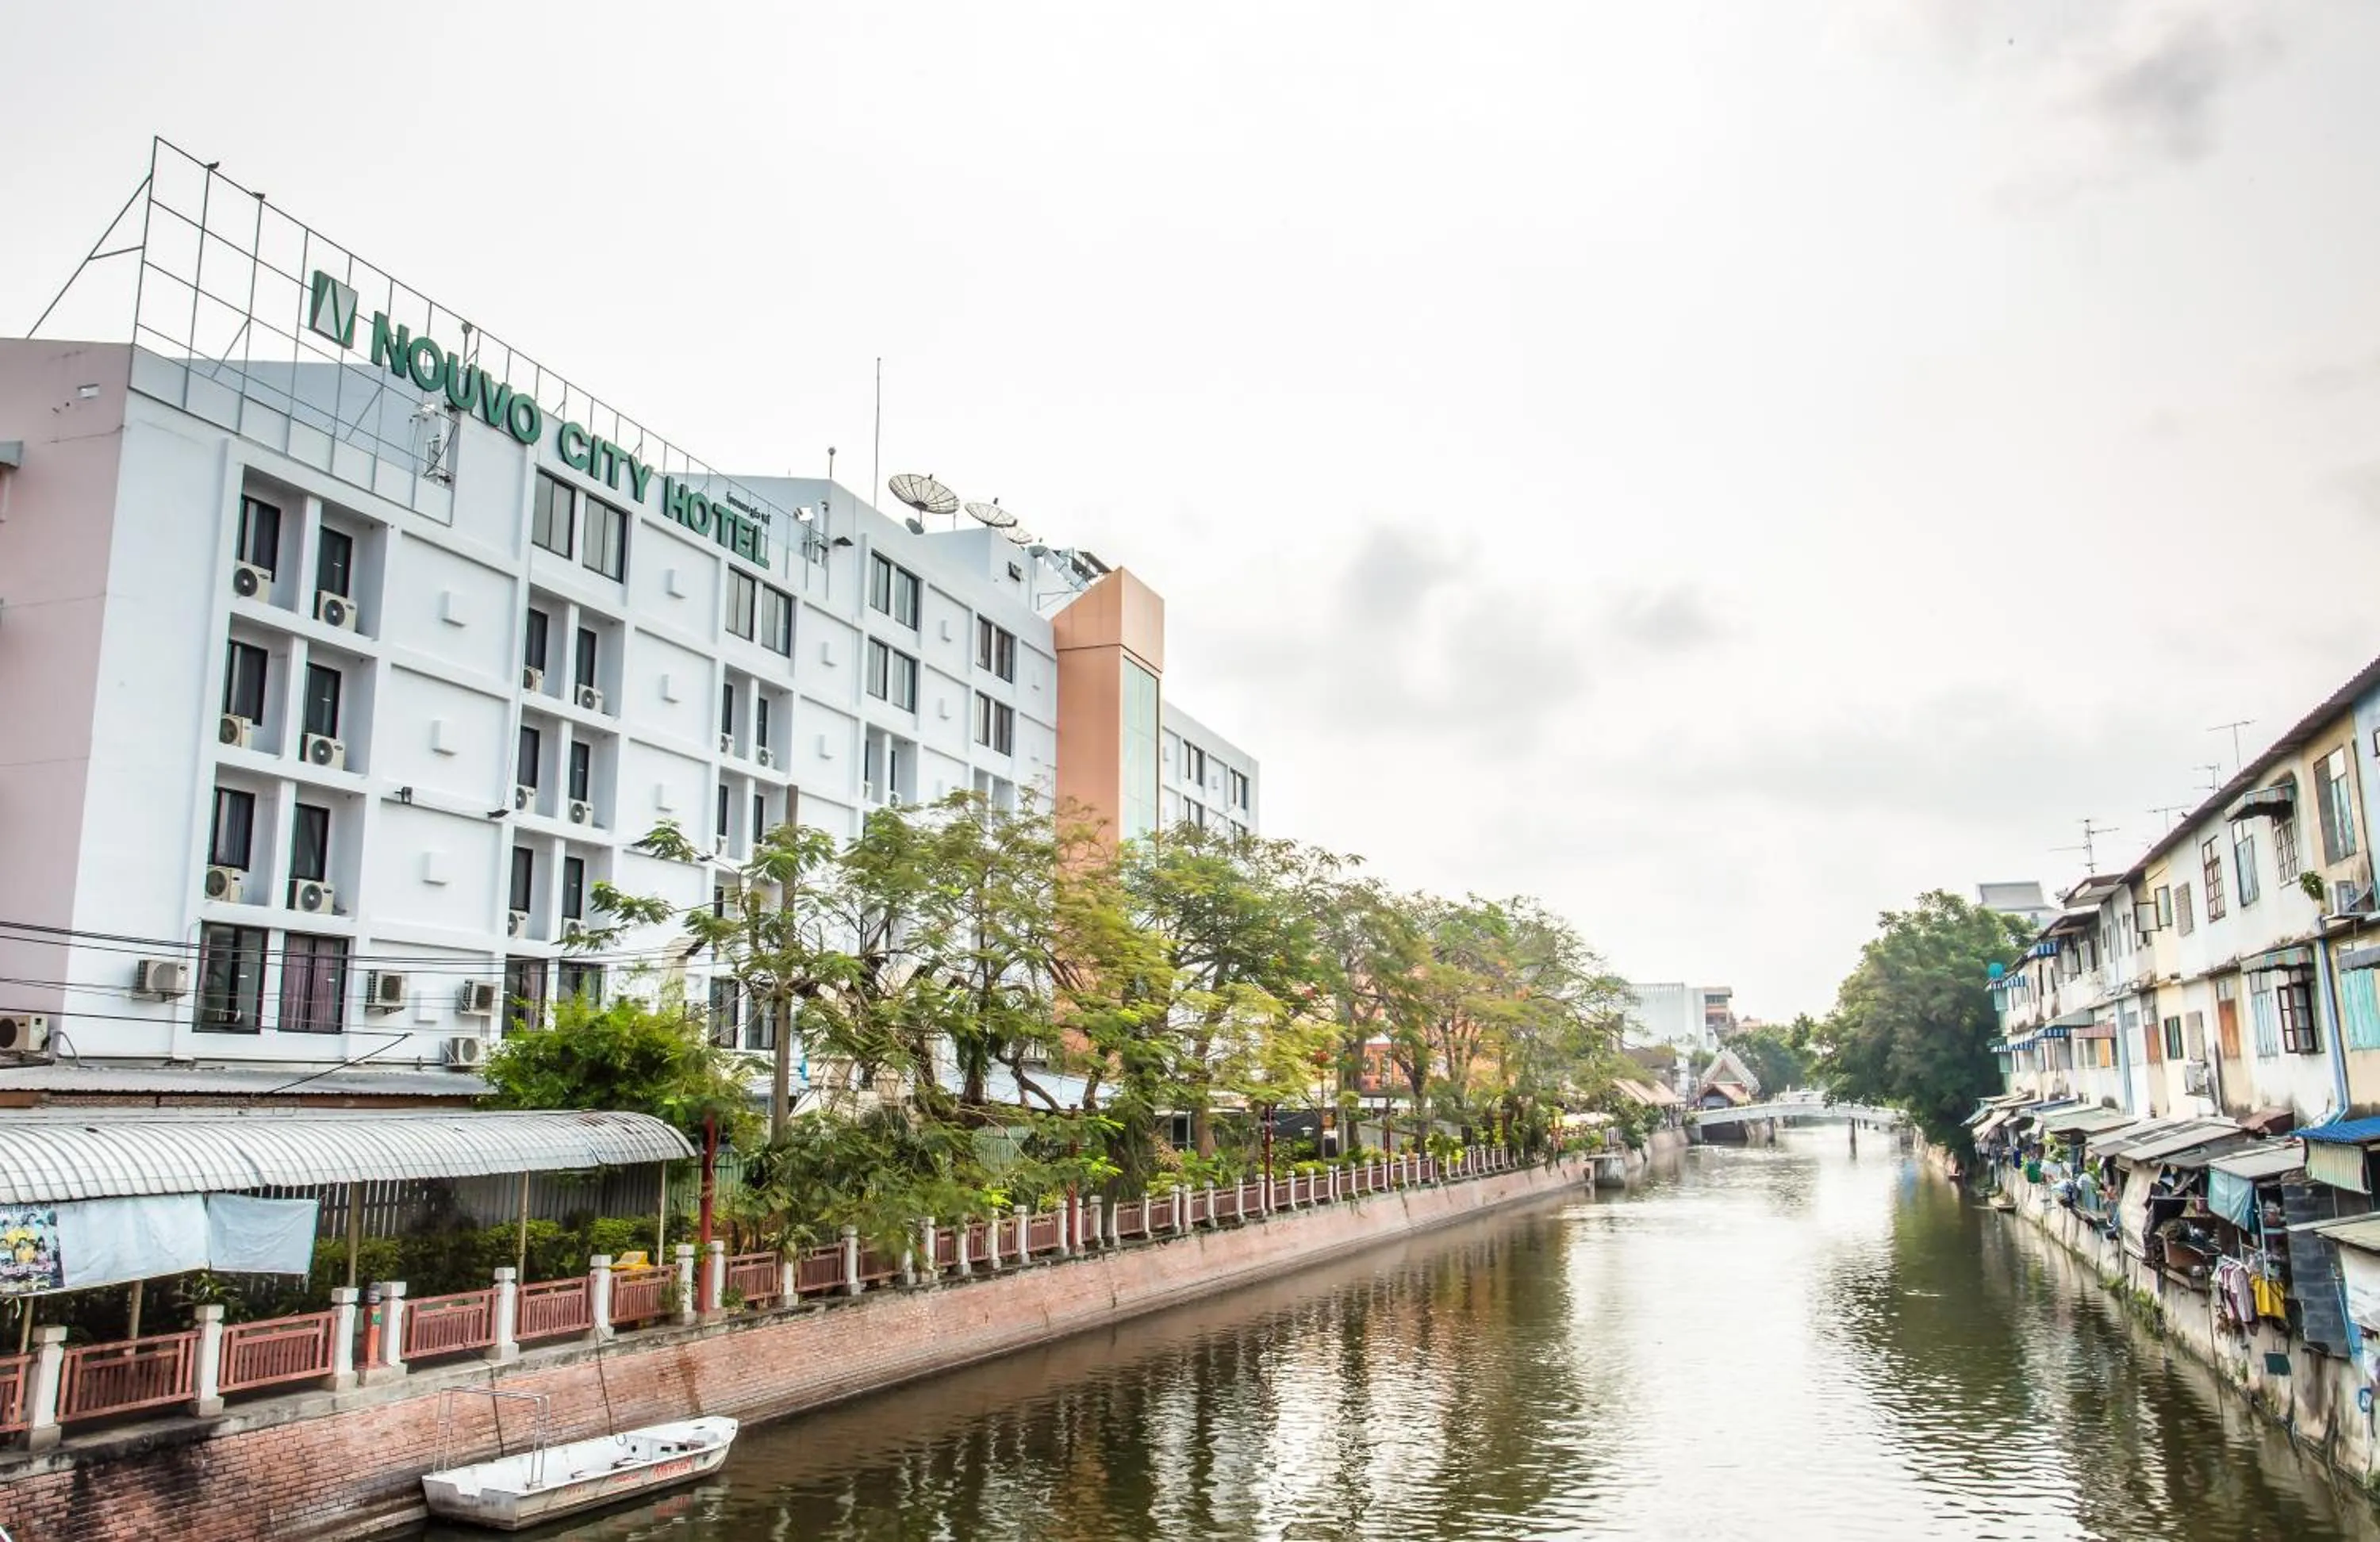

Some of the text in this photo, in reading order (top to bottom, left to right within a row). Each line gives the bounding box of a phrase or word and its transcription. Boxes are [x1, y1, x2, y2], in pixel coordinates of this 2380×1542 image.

[371, 310, 770, 570] NOUVO CITY HOTEL
